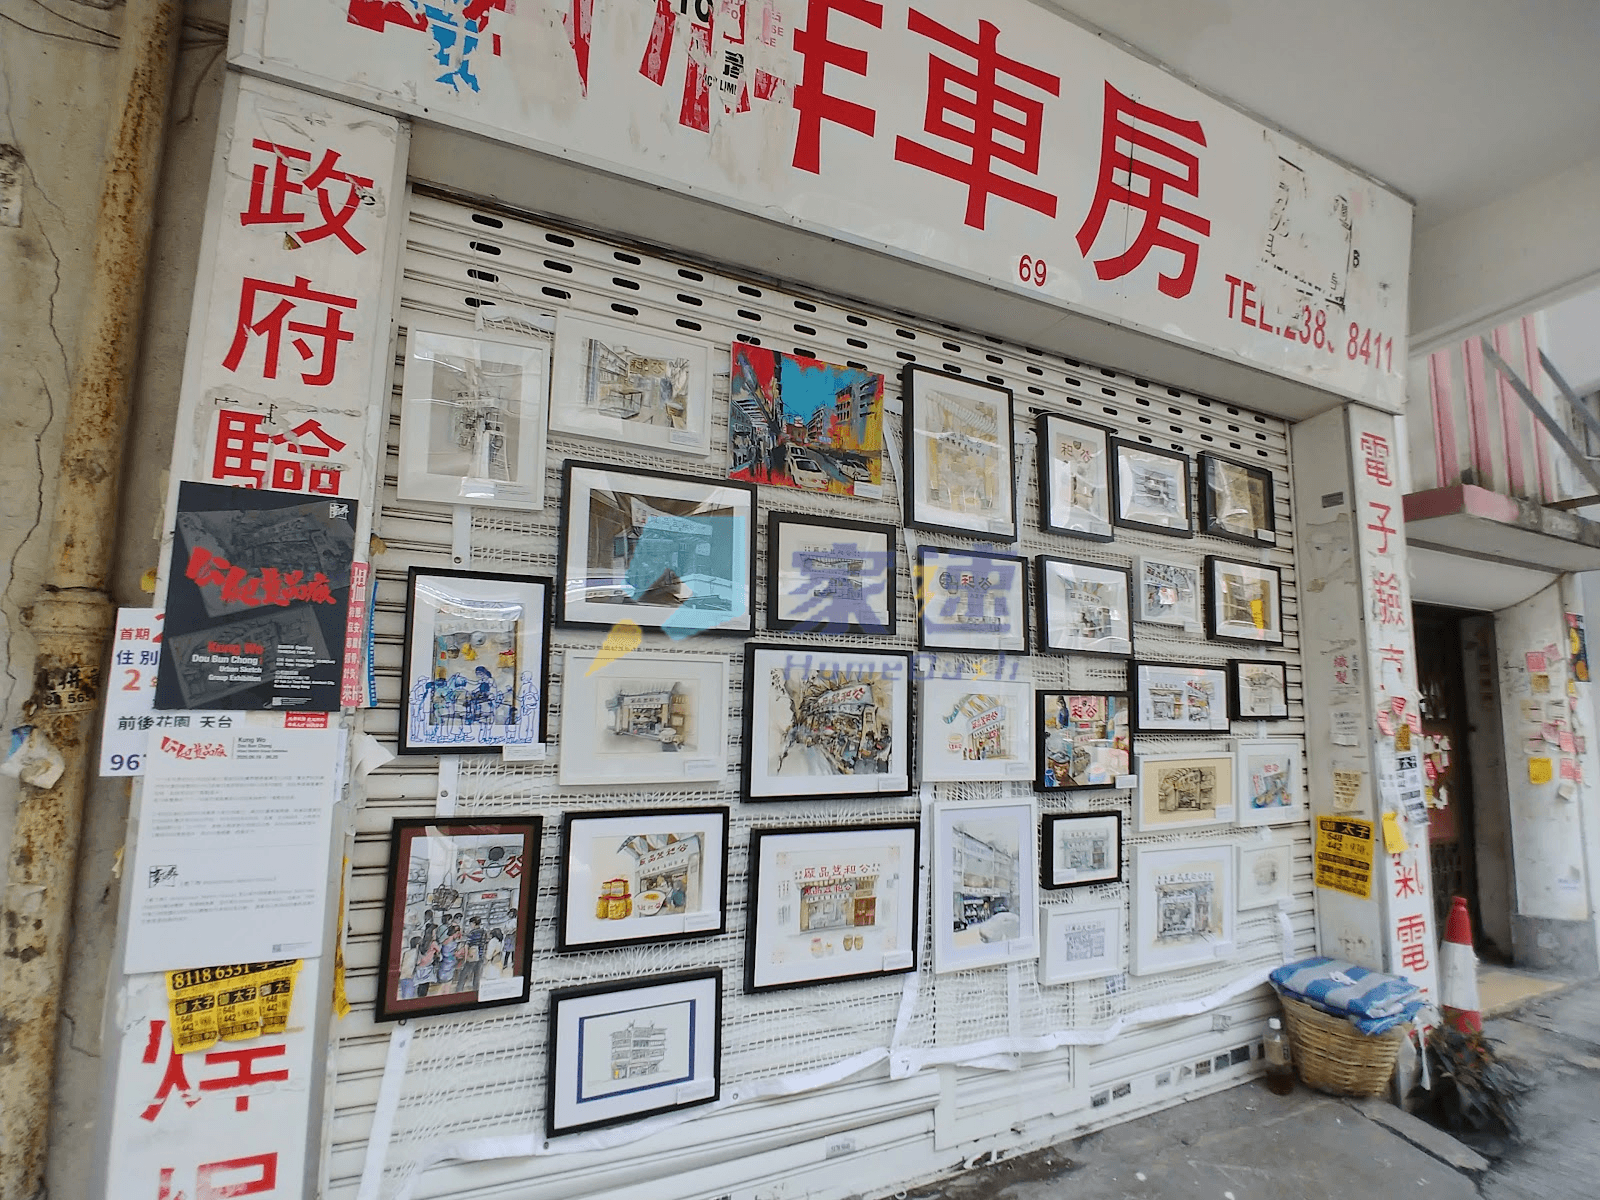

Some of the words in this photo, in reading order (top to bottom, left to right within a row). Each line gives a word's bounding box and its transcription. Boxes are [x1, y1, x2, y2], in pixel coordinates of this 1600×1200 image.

[1020, 254, 1047, 287] 69
[1346, 321, 1393, 373] 8411
[119, 628, 150, 641] 首期
[191, 654, 210, 663] Dou
[211, 655, 229, 663] Bun
[231, 656, 259, 665] Chong
[122, 669, 141, 691] 2
[118, 715, 191, 731] 前後花園
[200, 715, 233, 729] 天台
[110, 753, 148, 771] 96
[1342, 823, 1370, 839] 太子
[173, 968, 212, 989] 8118
[191, 996, 215, 1011] 太子
[234, 988, 256, 1003] 太子
